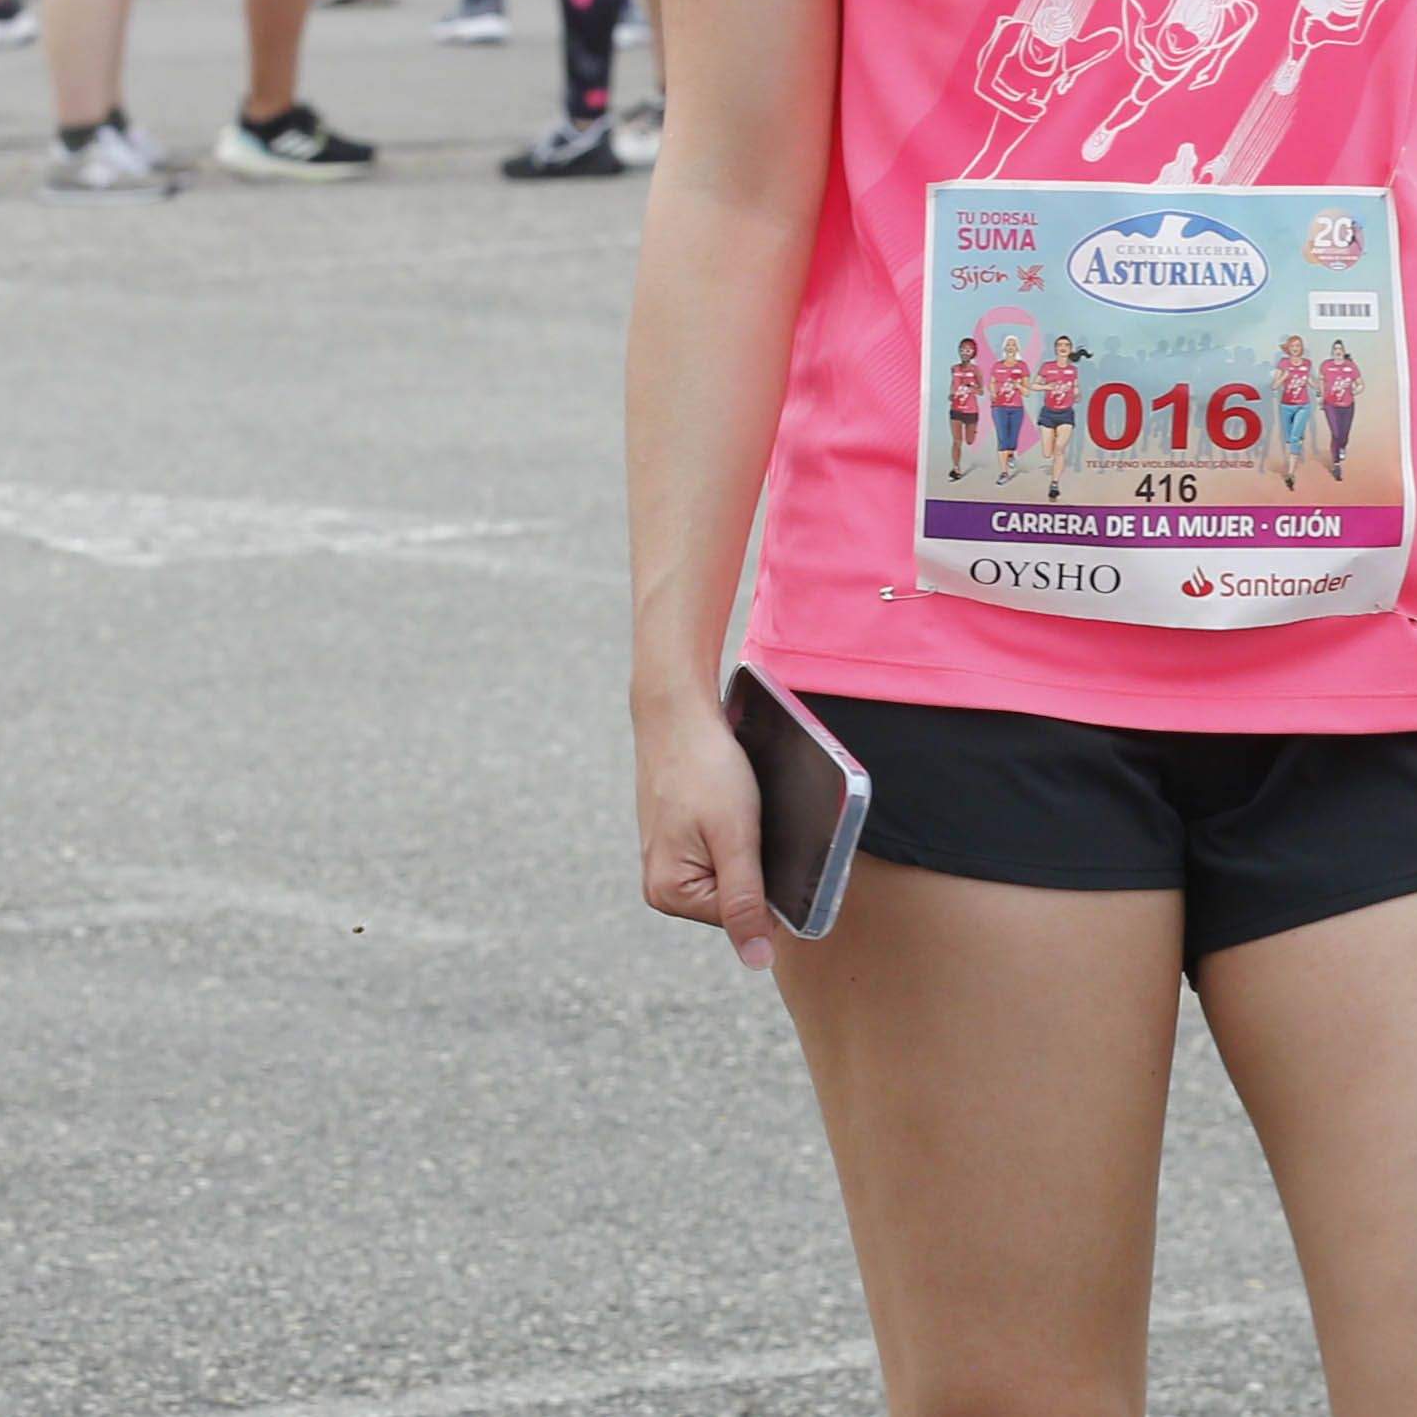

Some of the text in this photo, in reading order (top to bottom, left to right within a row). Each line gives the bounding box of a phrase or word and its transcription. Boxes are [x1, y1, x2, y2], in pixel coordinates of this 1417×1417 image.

[956, 211, 1039, 226] TU DORSAL
[957, 227, 1037, 251] SUMA
[1115, 244, 1249, 257] CENTRAL LECHERA
[1083, 246, 1256, 287] ASTURIANA
[1086, 382, 1263, 452] 016
[1134, 473, 1198, 503] 416
[991, 509, 1342, 539] CARRERA DE LA MUJER GIJÓN
[970, 558, 1353, 600] OYSHO Santander
